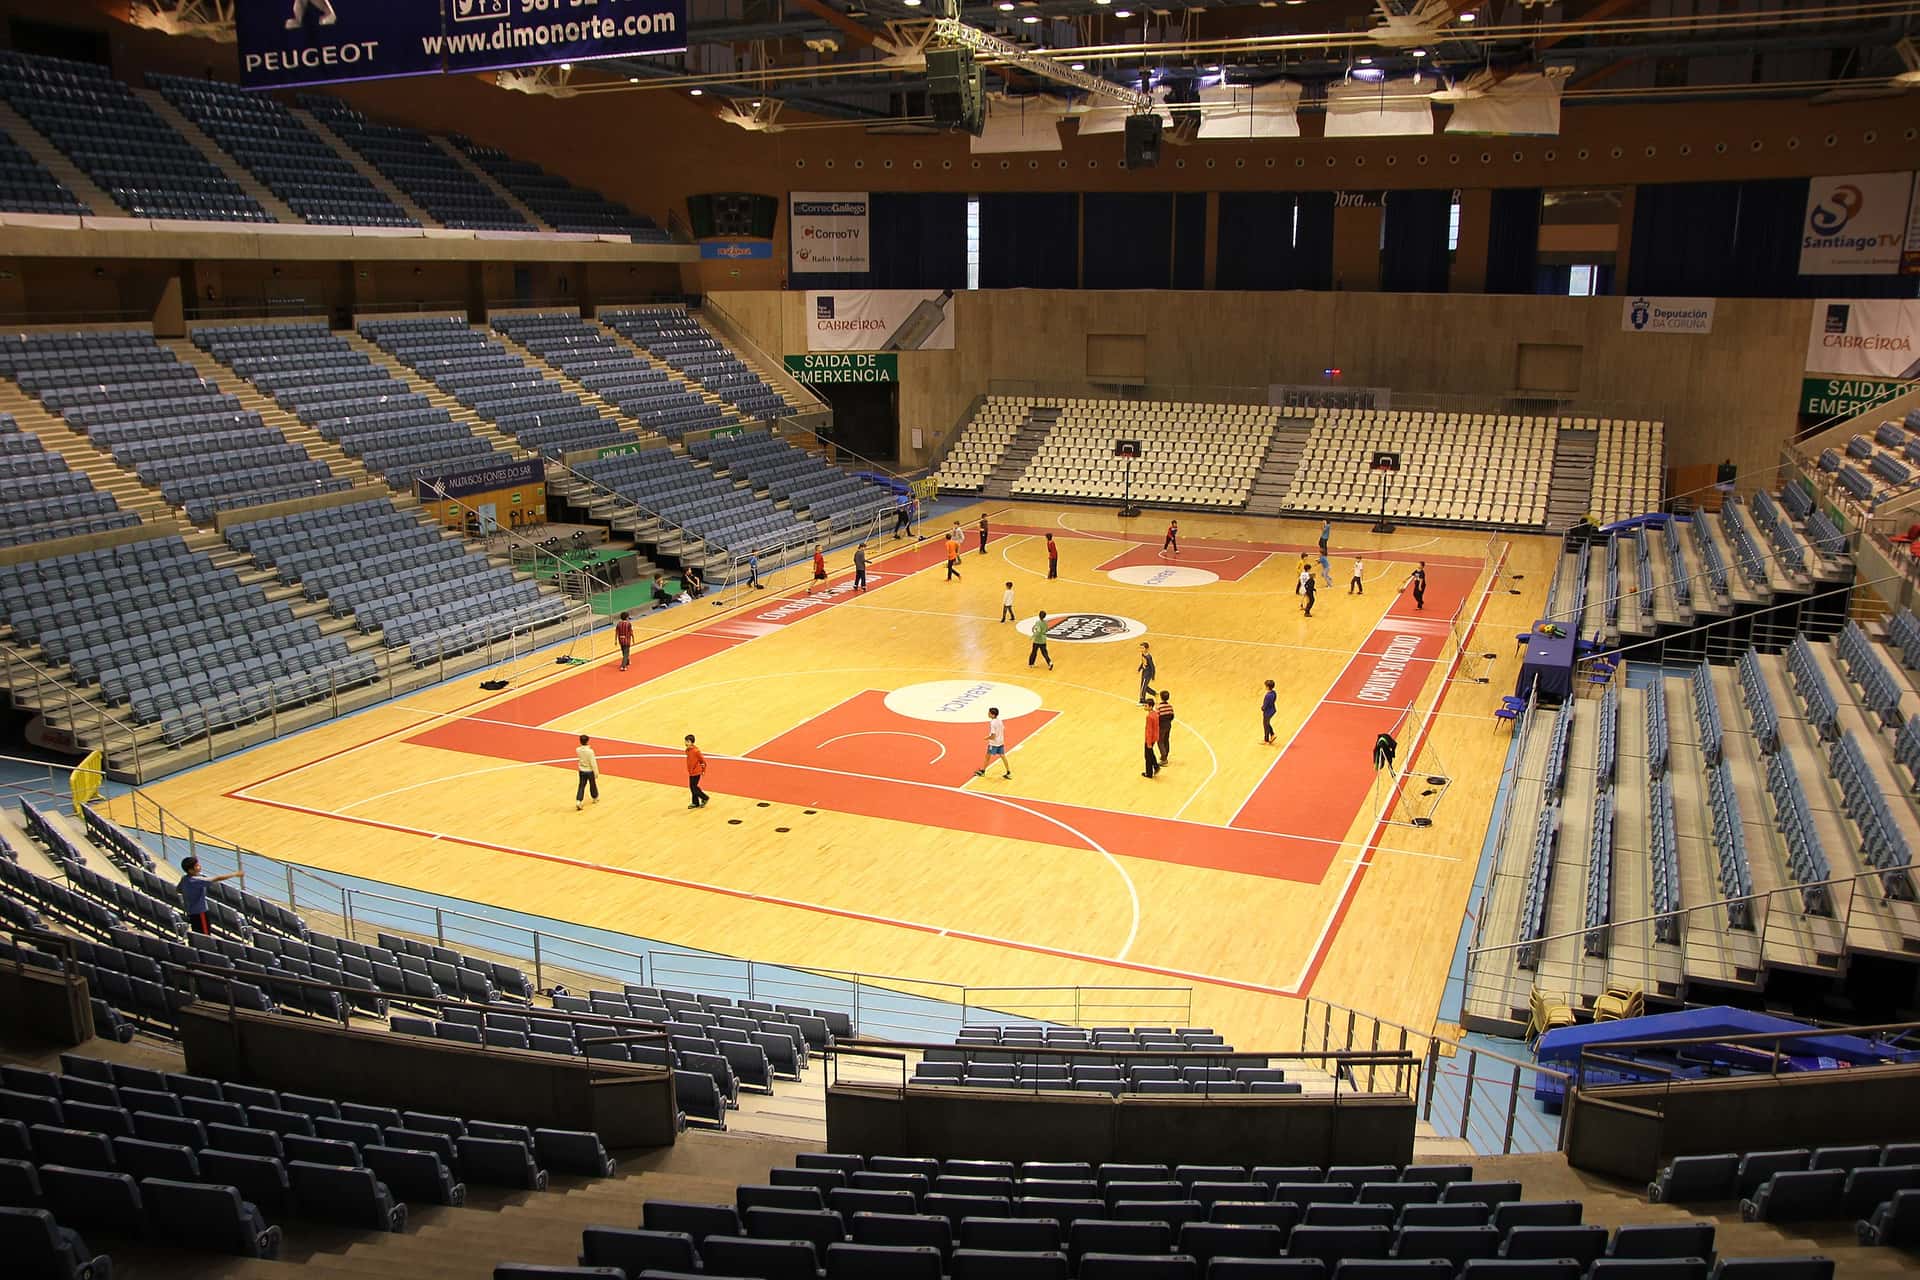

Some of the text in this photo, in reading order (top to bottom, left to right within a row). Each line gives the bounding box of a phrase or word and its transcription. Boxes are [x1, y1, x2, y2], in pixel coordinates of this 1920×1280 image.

[422, 11, 675, 55] www.dimonorte.com
[245, 41, 379, 73] PEUGEOT
[815, 229, 859, 239] CorreoTV
[1803, 233, 1902, 251] SantiagoTV
[804, 354, 876, 367] SAIDA DE
[1828, 380, 1888, 398] SAIDA
